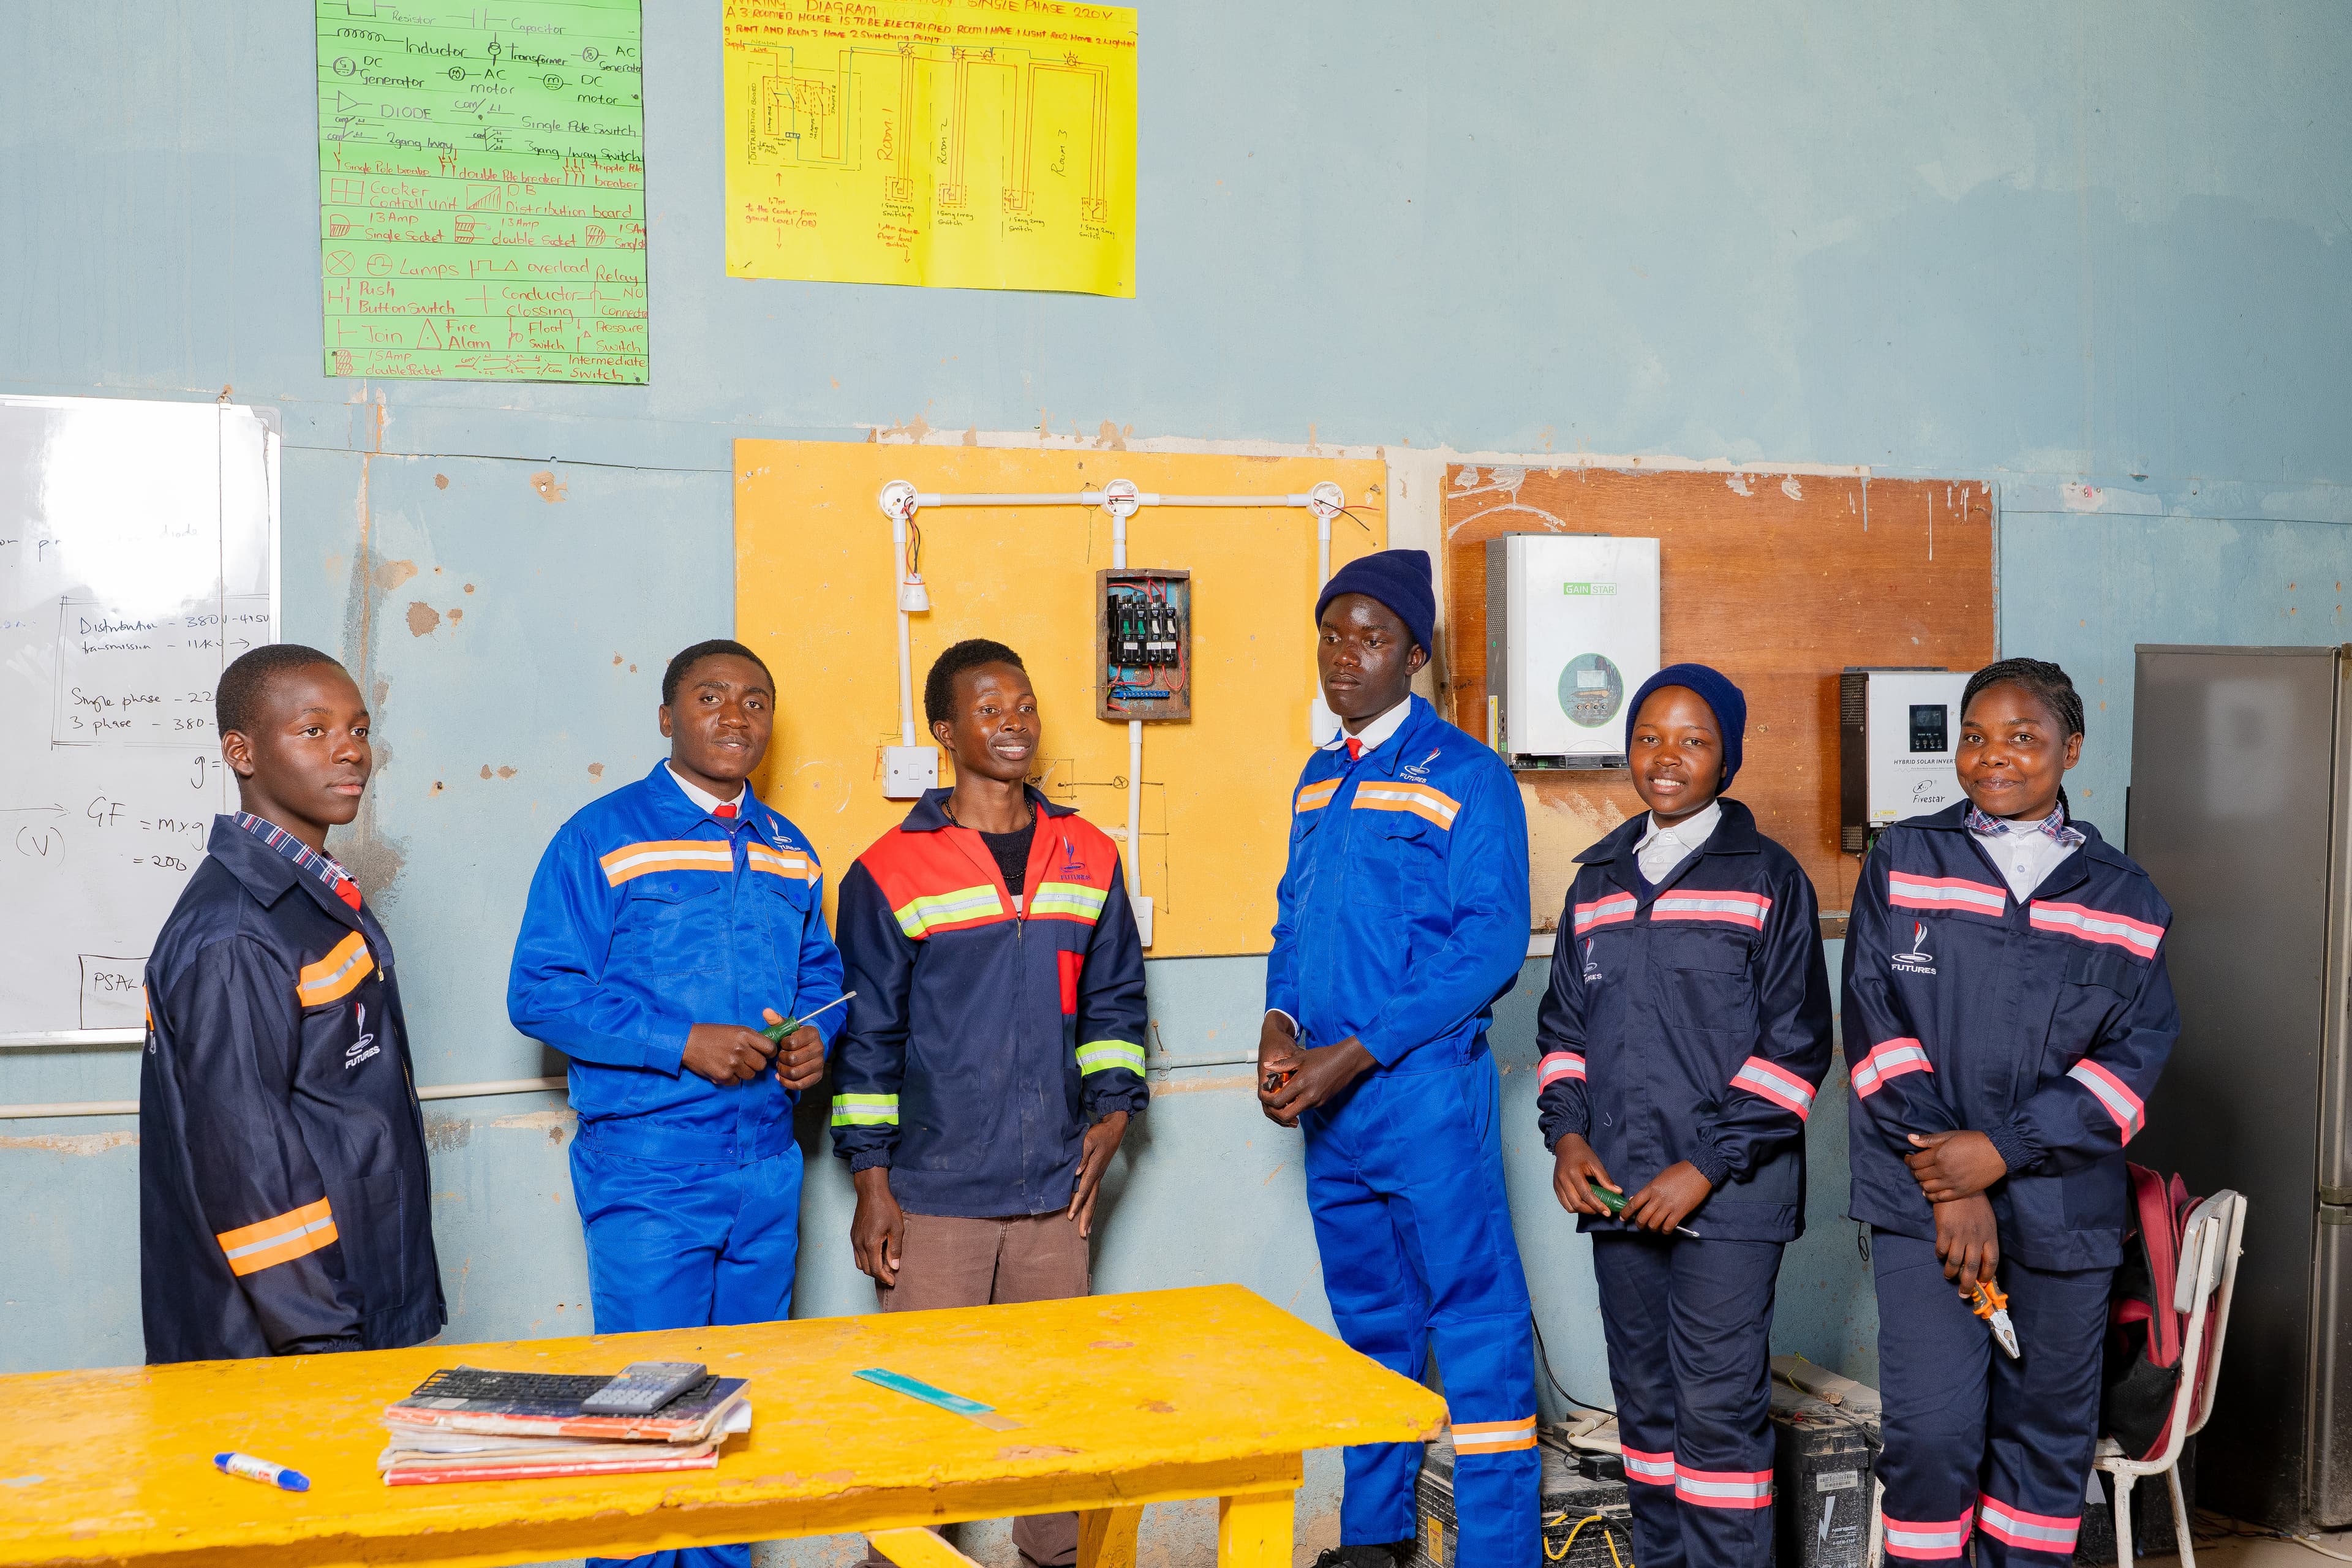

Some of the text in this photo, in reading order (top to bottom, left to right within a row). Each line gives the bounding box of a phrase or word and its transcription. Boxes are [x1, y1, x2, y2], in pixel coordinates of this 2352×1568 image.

[807, 0, 876, 17] DIAGRAM
[1025, 0, 1067, 14] PHASE
[1074, 7, 1113, 20] 220V
[392, 10, 436, 24] Resistor
[726, 6, 735, 18] A
[740, 8, 748, 18] 3
[799, 13, 832, 23] HOUSE
[884, 19, 951, 34] ELECTRIFIED
[511, 17, 567, 36] Capacitor
[763, 26, 783, 36] AND
[407, 37, 468, 58] Inductor
[616, 46, 636, 57] AC
[364, 56, 383, 67] DC
[360, 69, 424, 88] Generator
[484, 69, 507, 80] AC
[581, 75, 603, 87] DC
[470, 83, 515, 94] motor
[578, 94, 619, 105] motor
[381, 104, 432, 120] DIODE
[522, 116, 562, 133] Single
[601, 149, 644, 162] Switch
[375, 160, 394, 174] Pole
[459, 167, 497, 181] double
[371, 181, 431, 197] Cooker
[595, 175, 639, 189] breaker
[506, 201, 632, 218] Distribution board
[758, 205, 769, 213] the
[365, 228, 403, 243] Single
[492, 230, 535, 245] double
[399, 258, 459, 279] Lamps
[527, 258, 590, 274] overload
[595, 265, 638, 287] Relay
[360, 281, 395, 298] Push
[502, 285, 582, 301] Conductor
[623, 287, 644, 300] NO
[445, 319, 480, 334] Fire
[361, 325, 403, 344] Join
[448, 336, 491, 350] Alam
[529, 339, 565, 350] Switch
[596, 340, 642, 353] Switch
[568, 353, 648, 368] Intermediate
[570, 368, 624, 382] Switch
[1566, 584, 1589, 594] GAIN
[123, 693, 162, 711] phase
[69, 715, 132, 736] 3 phase
[1400, 772, 1427, 783] FUTURES
[1913, 794, 1946, 803] Fivestar
[1891, 963, 1937, 975] FUTURES
[345, 1045, 380, 1069] FUTURES
